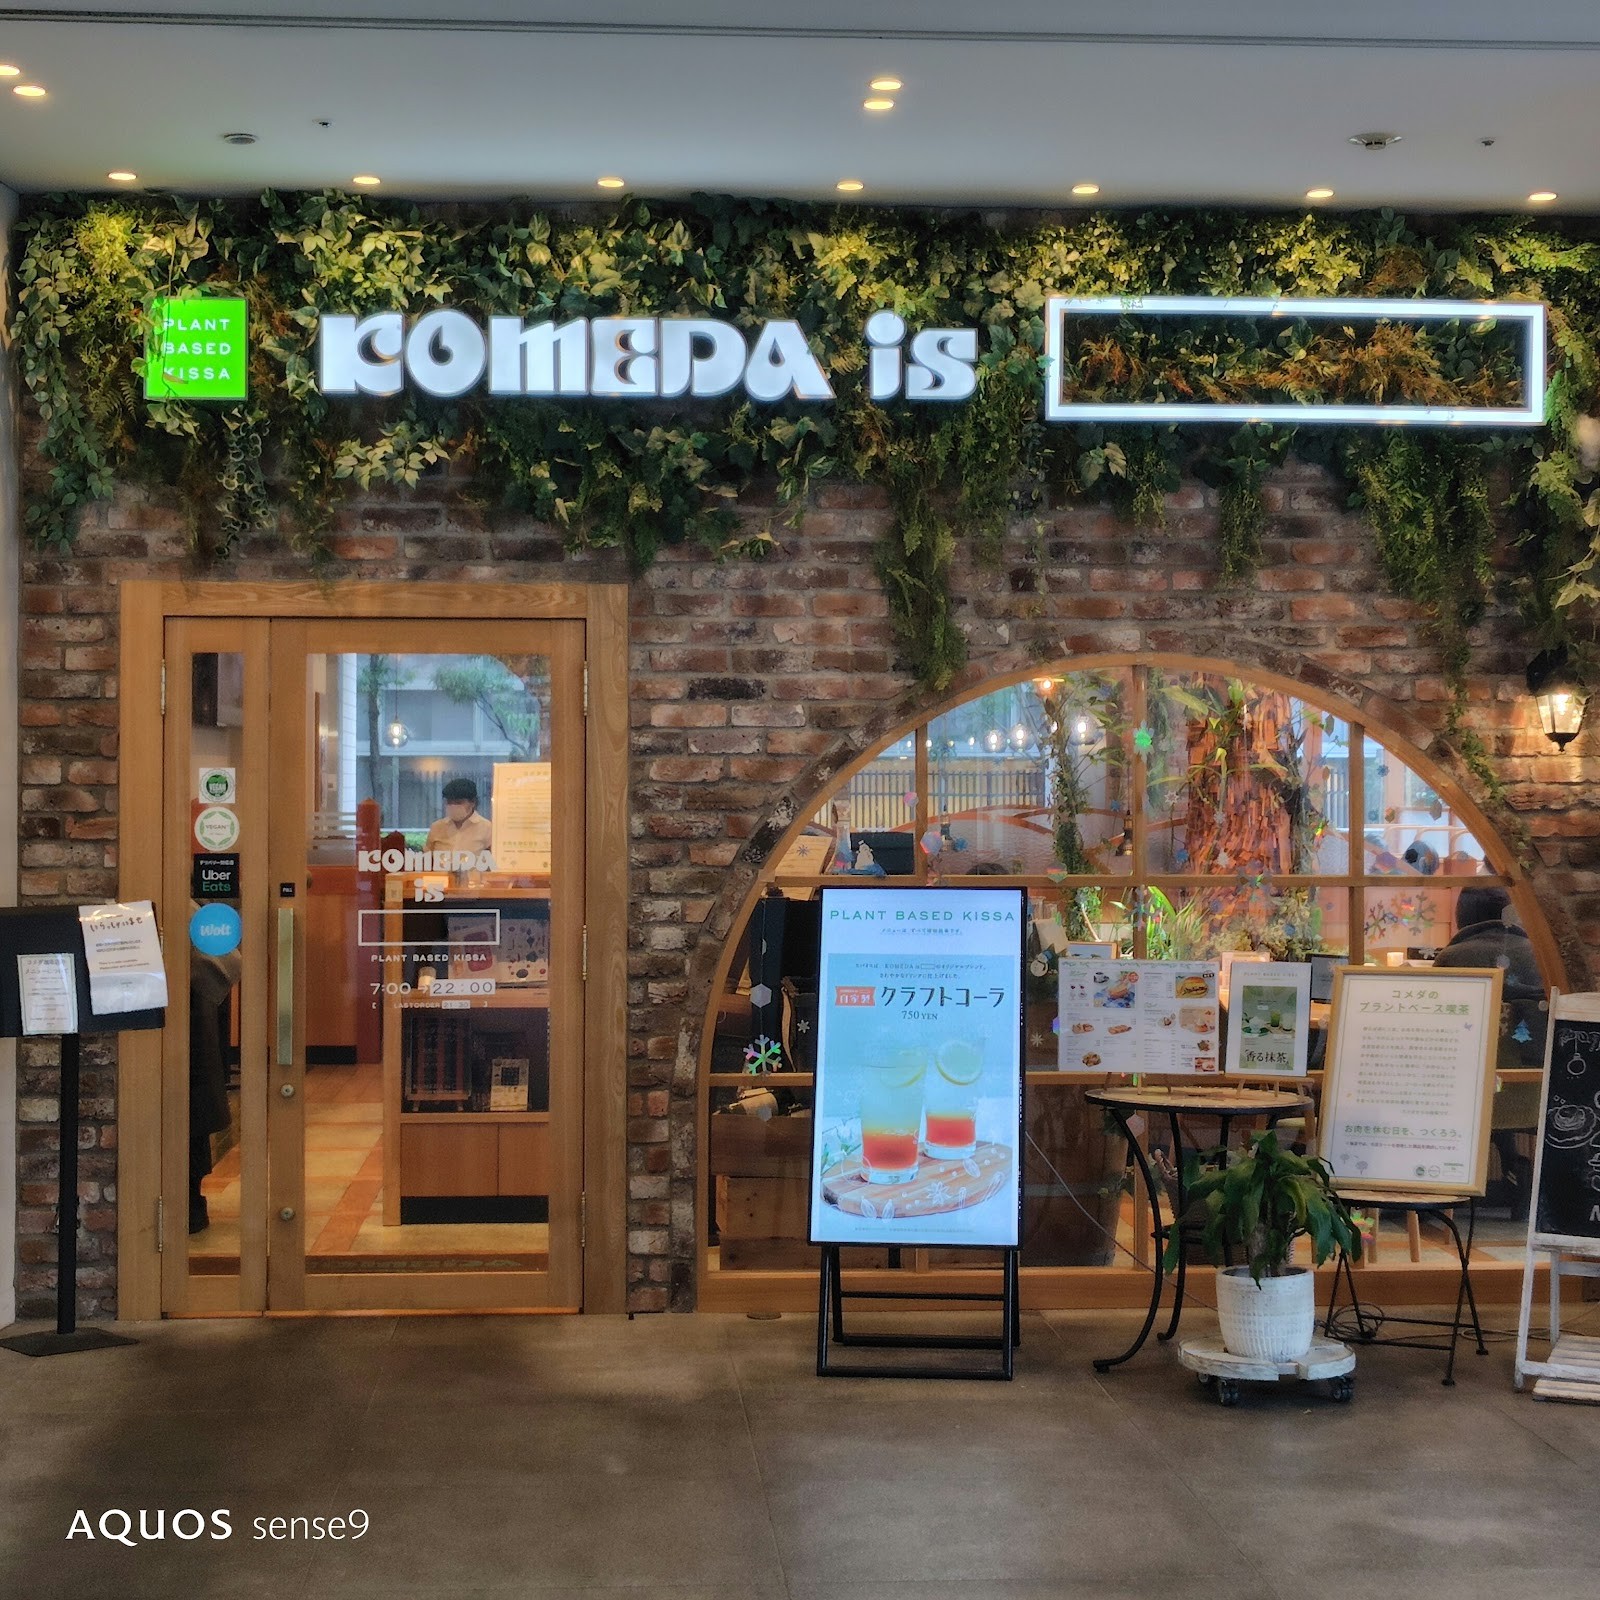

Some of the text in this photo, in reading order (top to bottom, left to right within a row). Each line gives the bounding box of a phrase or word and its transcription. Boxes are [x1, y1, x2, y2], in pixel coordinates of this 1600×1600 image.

[163, 318, 230, 331] PLANT
[163, 342, 231, 355] BASED
[319, 308, 979, 401] KOMEDA is
[163, 366, 231, 380] KISSA
[358, 848, 498, 873] KOMEDA
[202, 869, 232, 881] Uber
[202, 881, 231, 893] Eats
[413, 878, 445, 903] is
[830, 910, 1015, 922] PLANT BASED KISSA
[370, 953, 487, 962] PLANT BASED KISSA
[370, 982, 412, 995] 7:00
[1391, 989, 1440, 1000] コメダの
[880, 985, 1005, 1008] クラフトコーラ
[901, 1010, 938, 1020] 750 YEN
[1359, 1001, 1471, 1016] プラントベース喫茶
